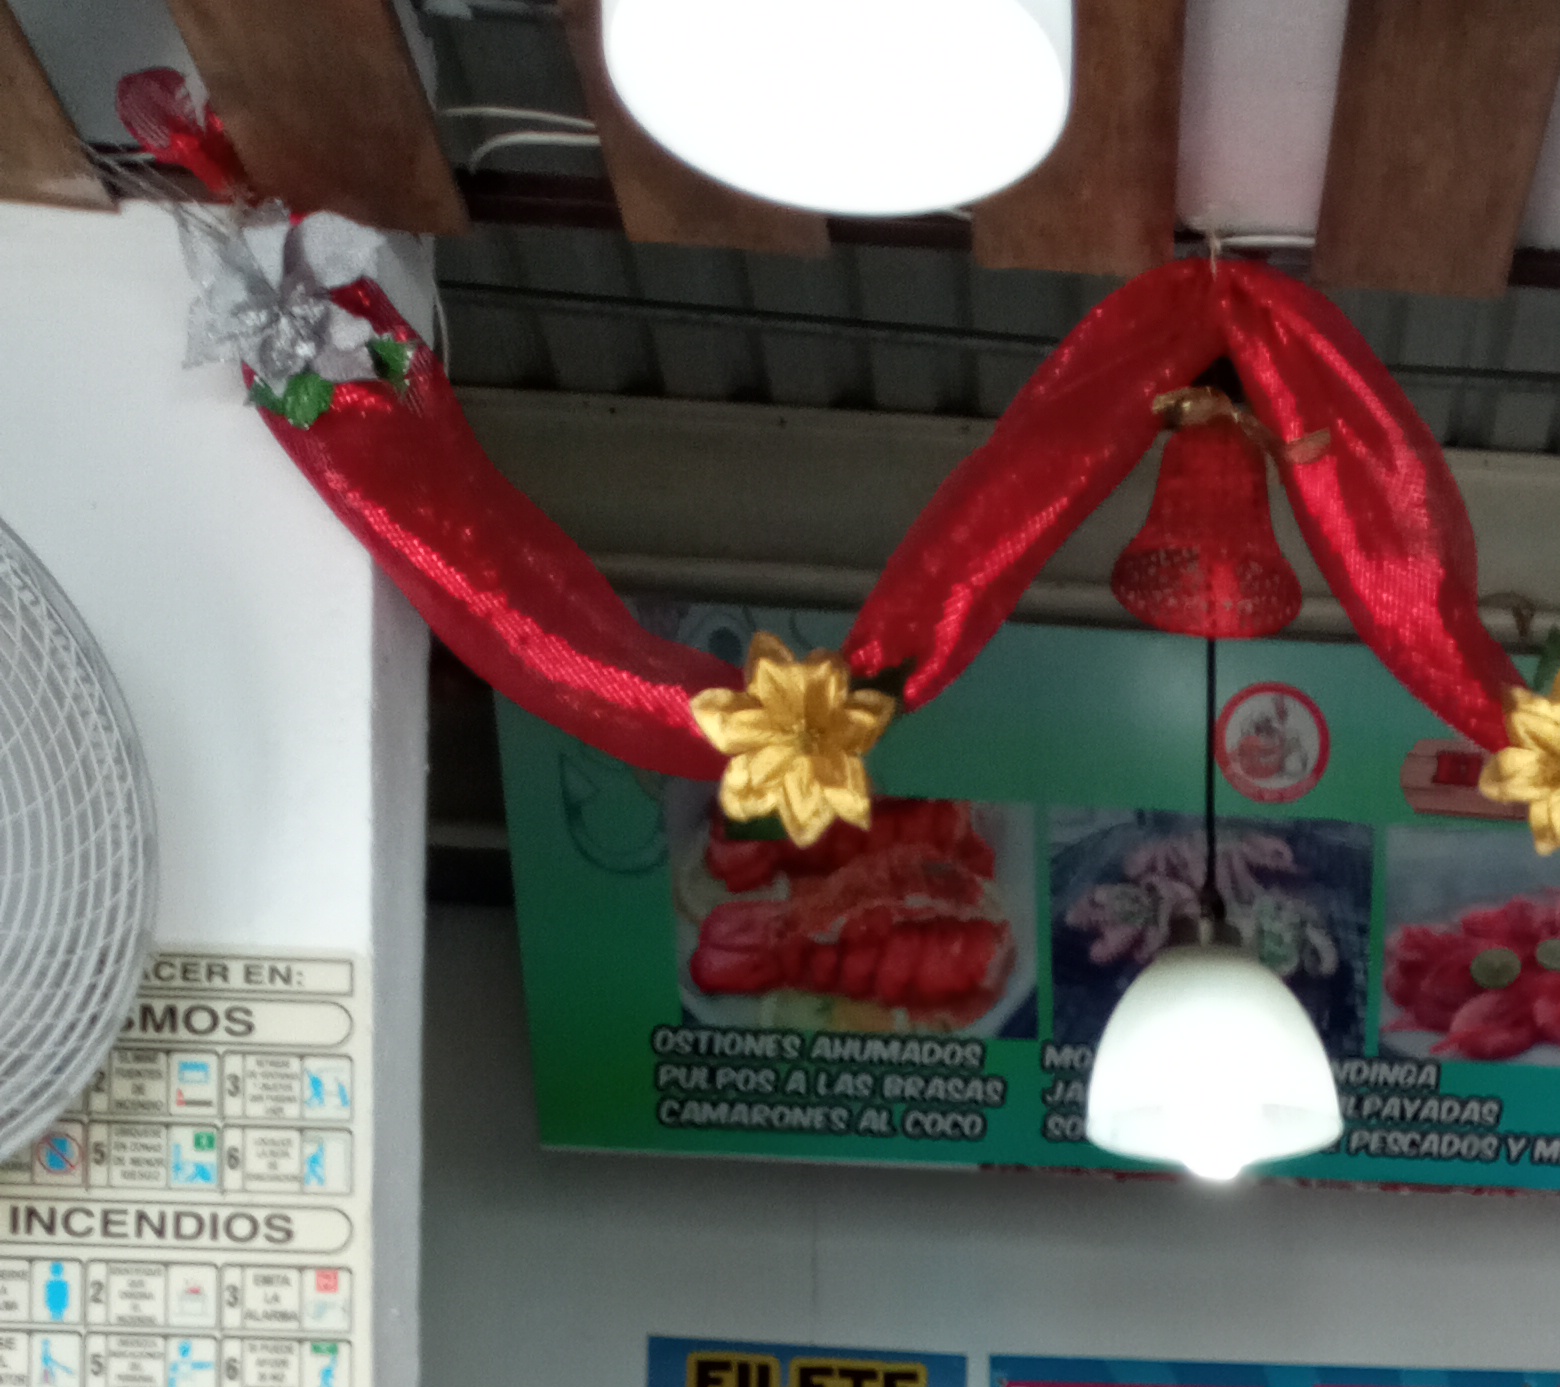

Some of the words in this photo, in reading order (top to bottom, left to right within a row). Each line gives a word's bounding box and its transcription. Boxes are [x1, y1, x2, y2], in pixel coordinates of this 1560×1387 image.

[144, 961, 231, 985] CER
[243, 964, 305, 987] EN:
[124, 1003, 256, 1038] MOS
[654, 1028, 803, 1060] OSTIONES
[810, 1035, 984, 1067] AHUMADOS
[226, 1073, 241, 1098] 3
[657, 1064, 778, 1093] PULPOS
[784, 1069, 808, 1096] A
[815, 1071, 875, 1098] LAS
[882, 1075, 1007, 1104] BRASAS
[658, 1099, 852, 1131] CAMARONES
[857, 1107, 895, 1134] AL
[903, 1110, 984, 1138] COCO
[91, 1140, 105, 1166] 5
[226, 1144, 240, 1170] 6
[1349, 1130, 1500, 1162] PESCADOS
[1507, 1136, 1528, 1161] Y
[9, 1205, 296, 1244] INCENDIOS
[89, 1279, 105, 1304] 2
[226, 1284, 239, 1308] 3
[90, 1353, 104, 1377] 5
[225, 1356, 239, 1381] 6
